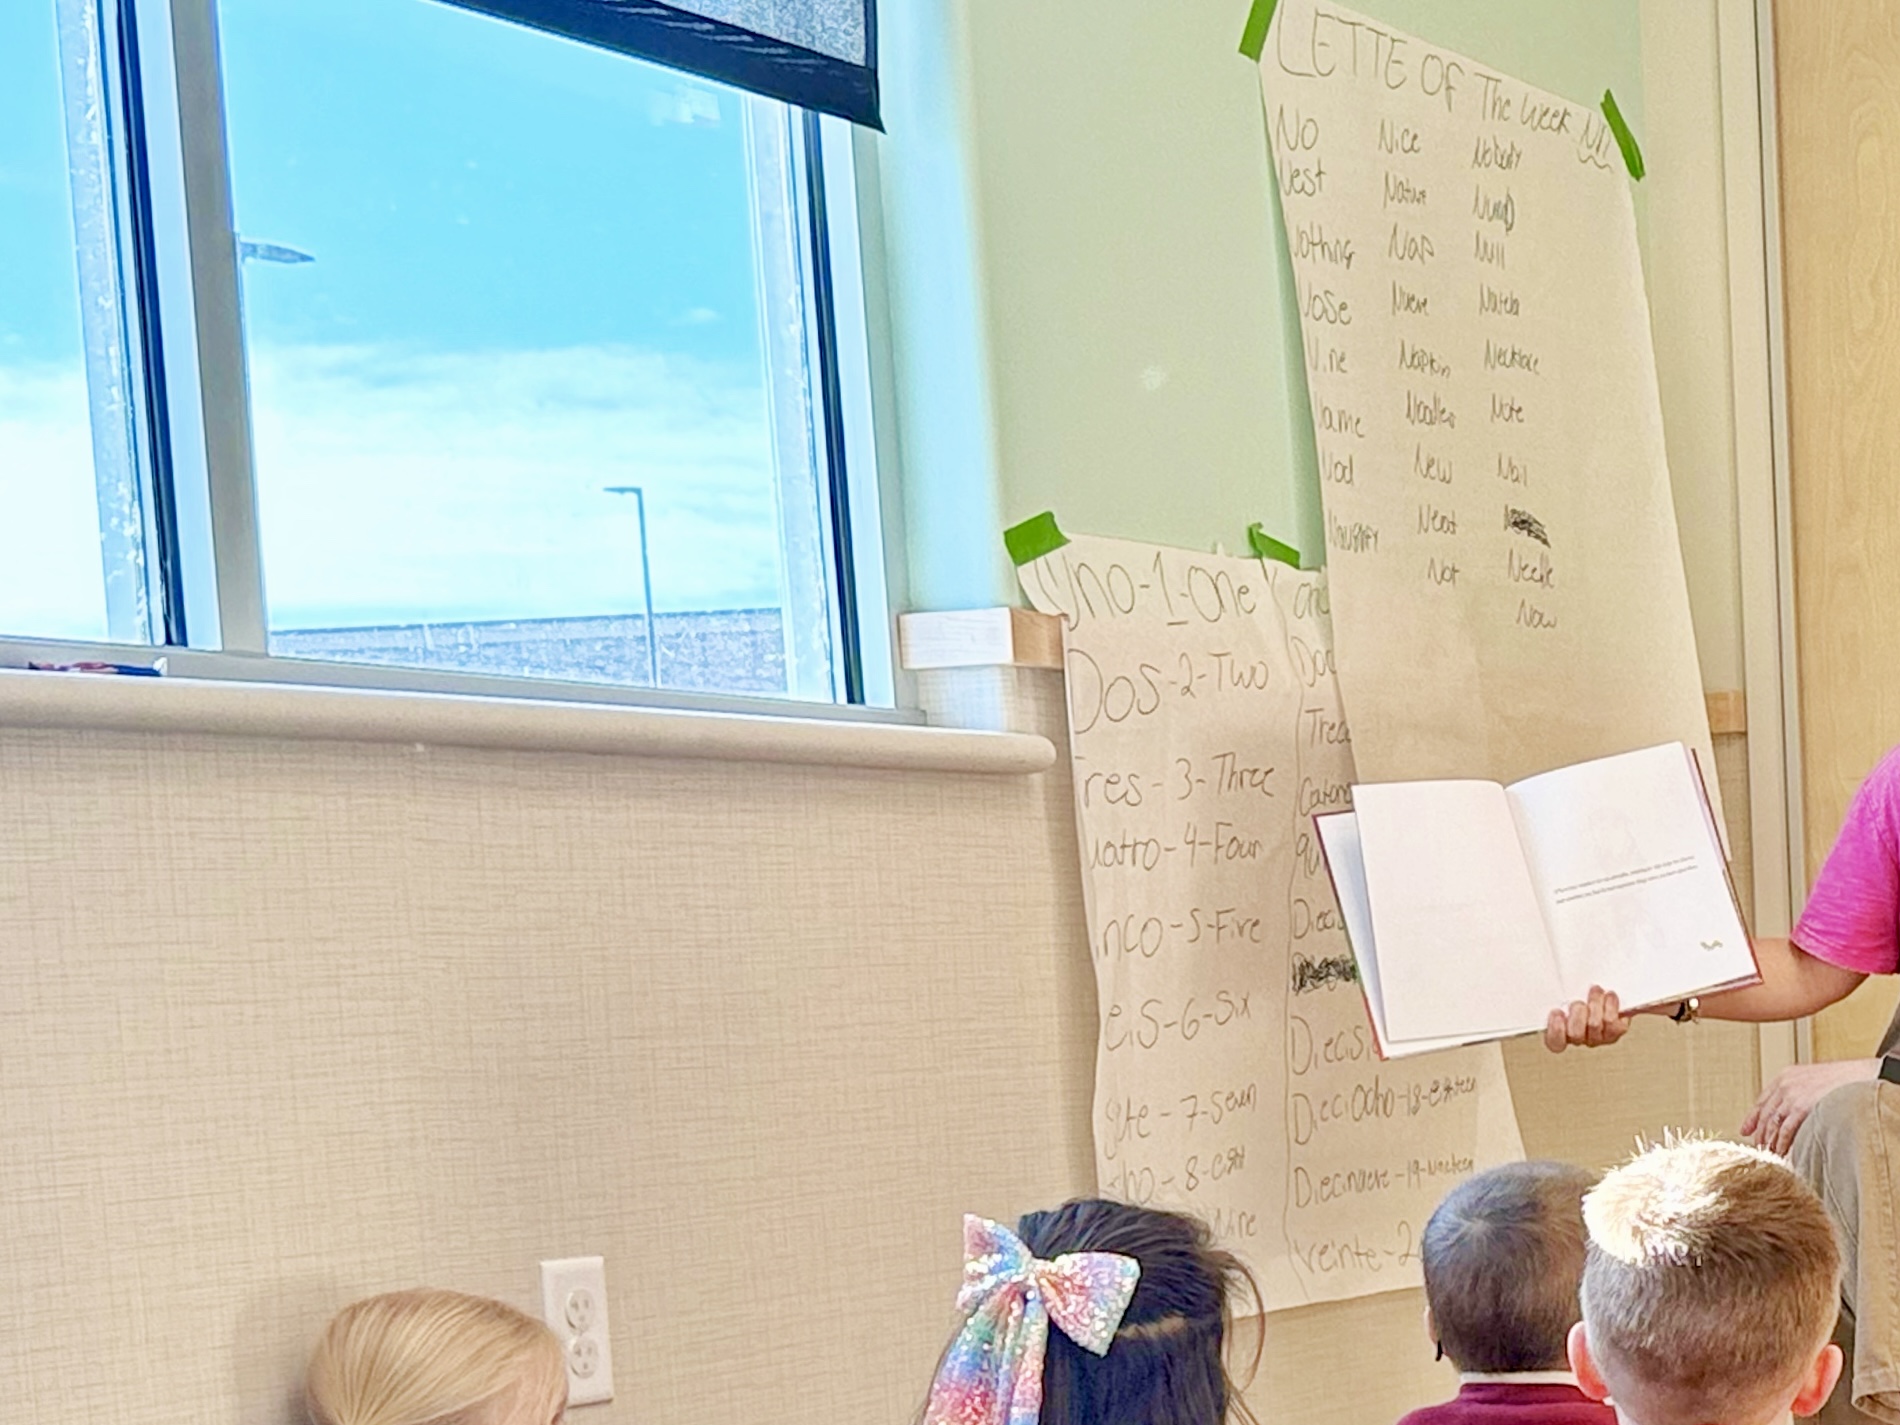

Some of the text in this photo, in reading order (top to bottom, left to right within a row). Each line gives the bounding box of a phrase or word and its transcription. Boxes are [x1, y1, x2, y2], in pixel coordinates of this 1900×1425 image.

[1474, 73, 1511, 121] The
[1378, 119, 1421, 154] Nice
[1388, 222, 1434, 265] Nap
